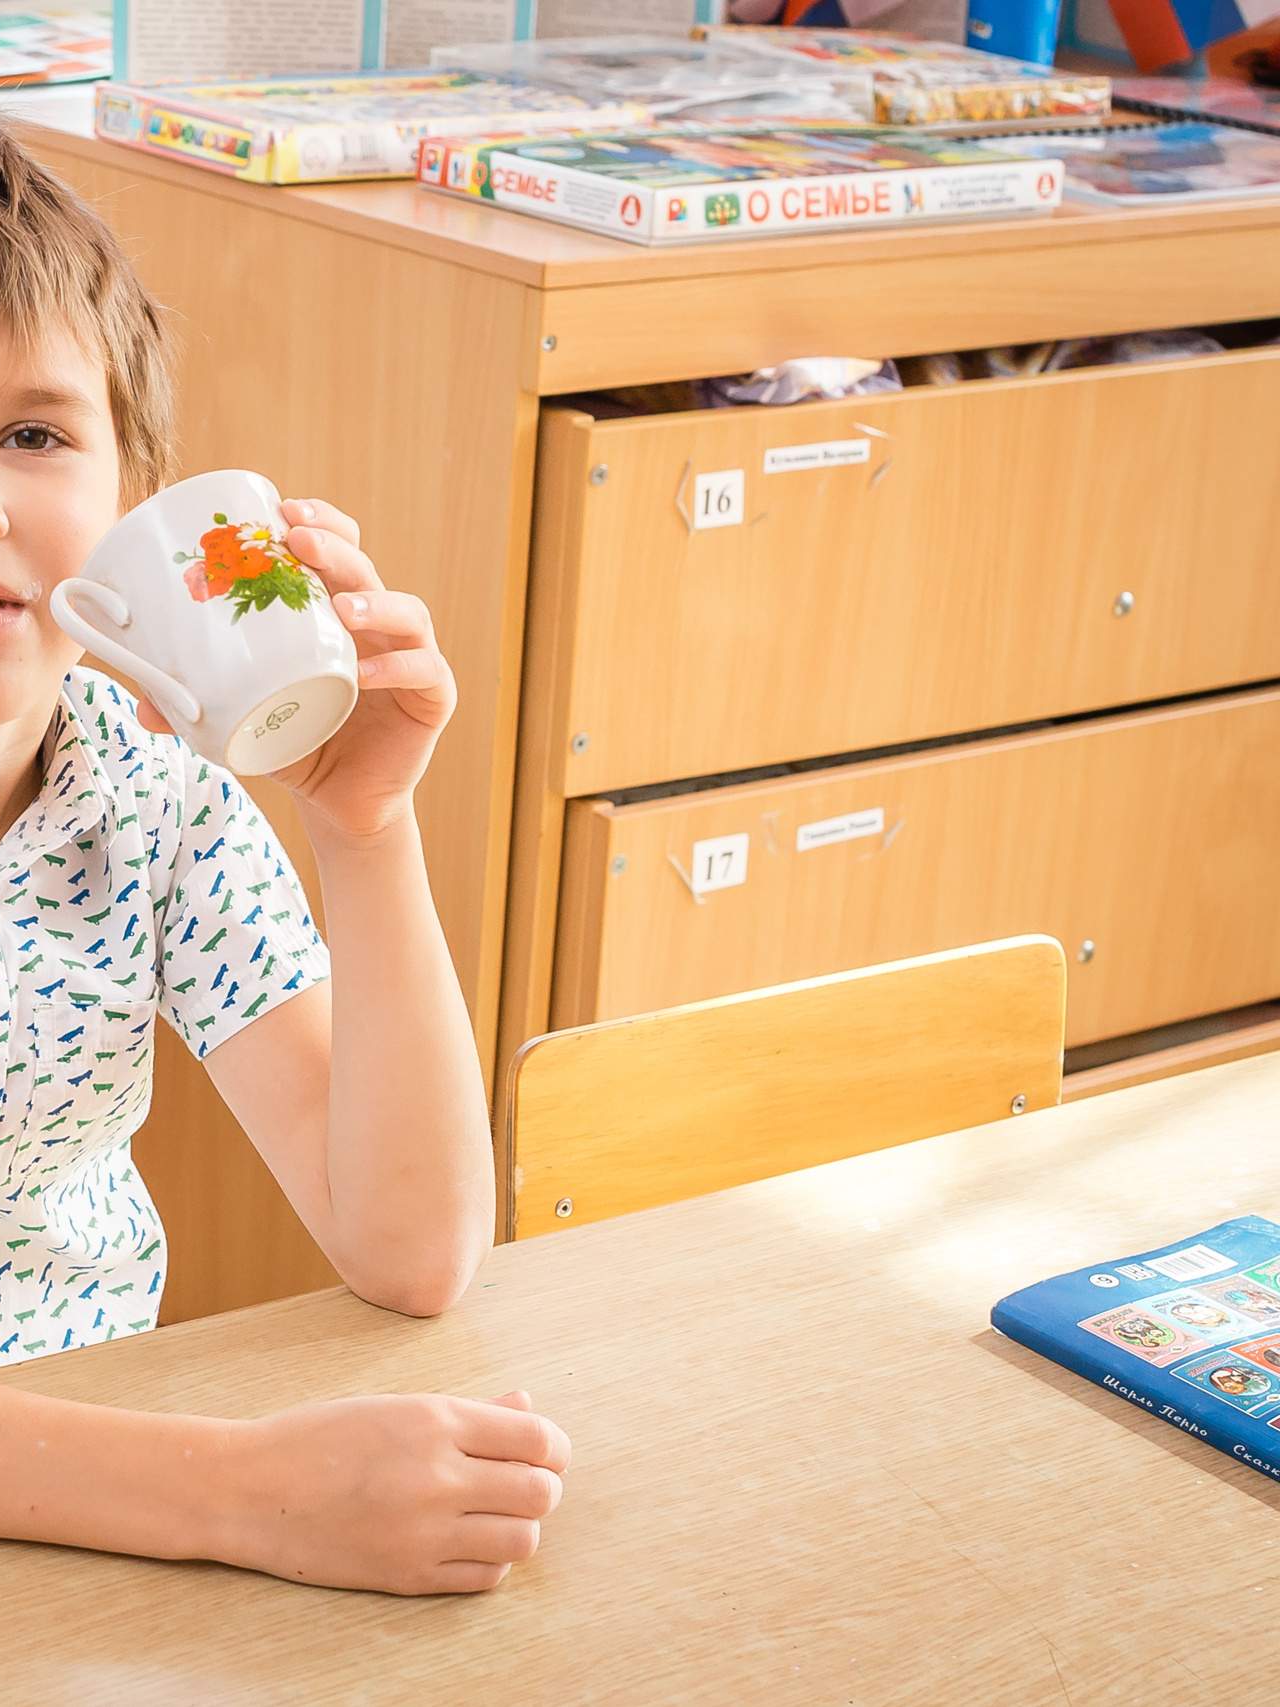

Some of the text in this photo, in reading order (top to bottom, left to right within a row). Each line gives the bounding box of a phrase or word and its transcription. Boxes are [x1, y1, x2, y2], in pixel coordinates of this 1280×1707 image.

[490, 168, 558, 204] СЕМЬЕ
[747, 189, 770, 223] О
[781, 181, 891, 221] СЕМЬЕ
[703, 483, 732, 516] 16
[706, 850, 733, 881] 17
[1103, 1374, 1154, 1408] Шарль
[1158, 1404, 1208, 1437] Перро
